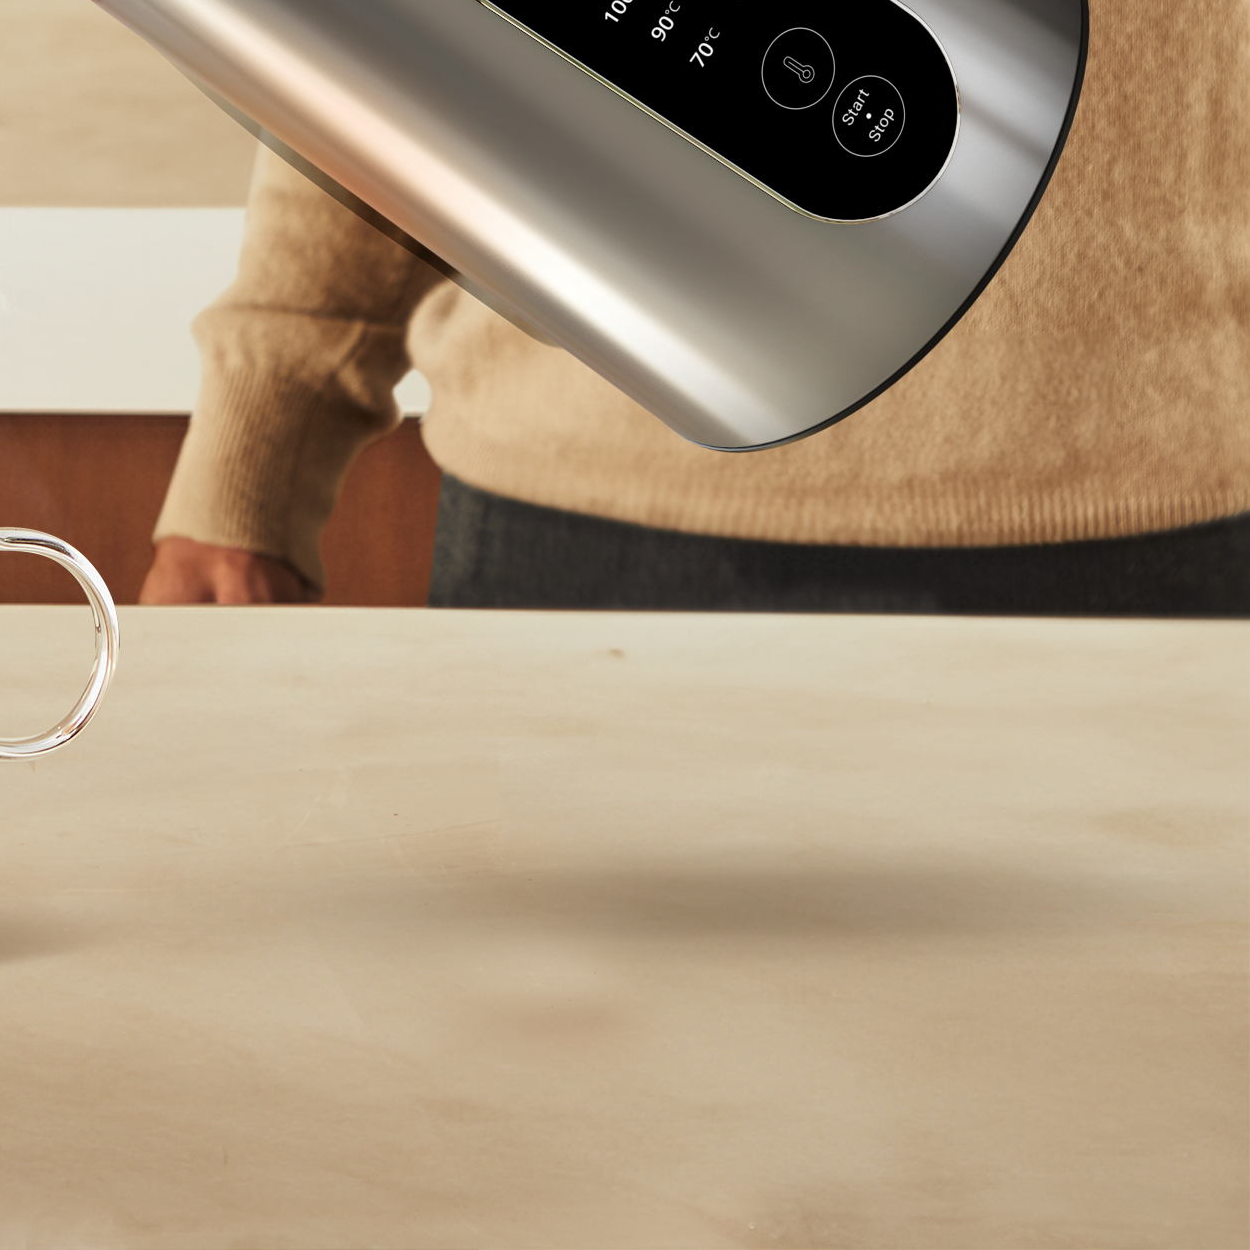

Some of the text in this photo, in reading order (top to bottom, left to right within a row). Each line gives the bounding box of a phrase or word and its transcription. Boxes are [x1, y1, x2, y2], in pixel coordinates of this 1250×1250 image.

[651, 0, 680, 42] 90°C
[689, 27, 720, 68] 70°C
[841, 88, 870, 126] Start
[868, 107, 895, 143] Stop
